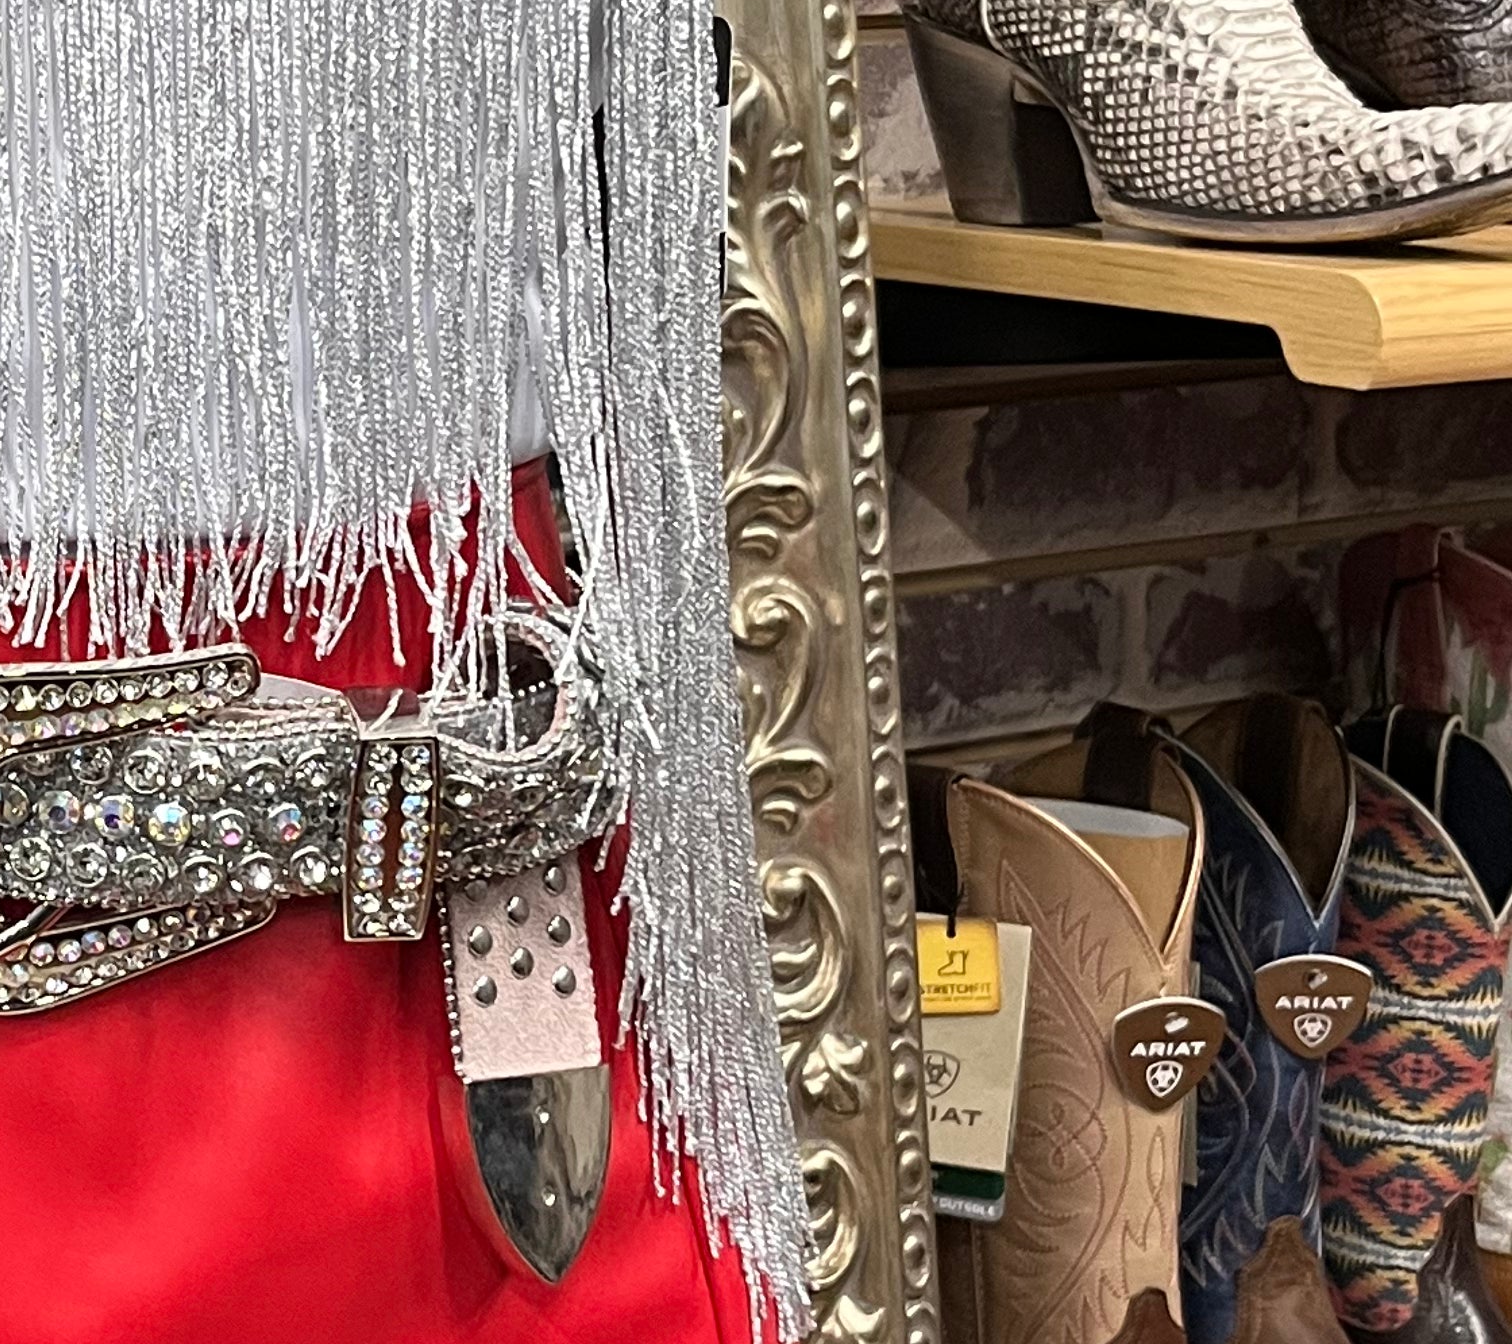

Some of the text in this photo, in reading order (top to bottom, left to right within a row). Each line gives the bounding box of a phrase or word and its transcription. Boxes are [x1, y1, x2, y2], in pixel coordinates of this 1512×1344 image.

[1274, 995, 1354, 1010] ARIAT
[1130, 1040, 1206, 1057] ARIAT
[930, 1105, 982, 1126] IAT
